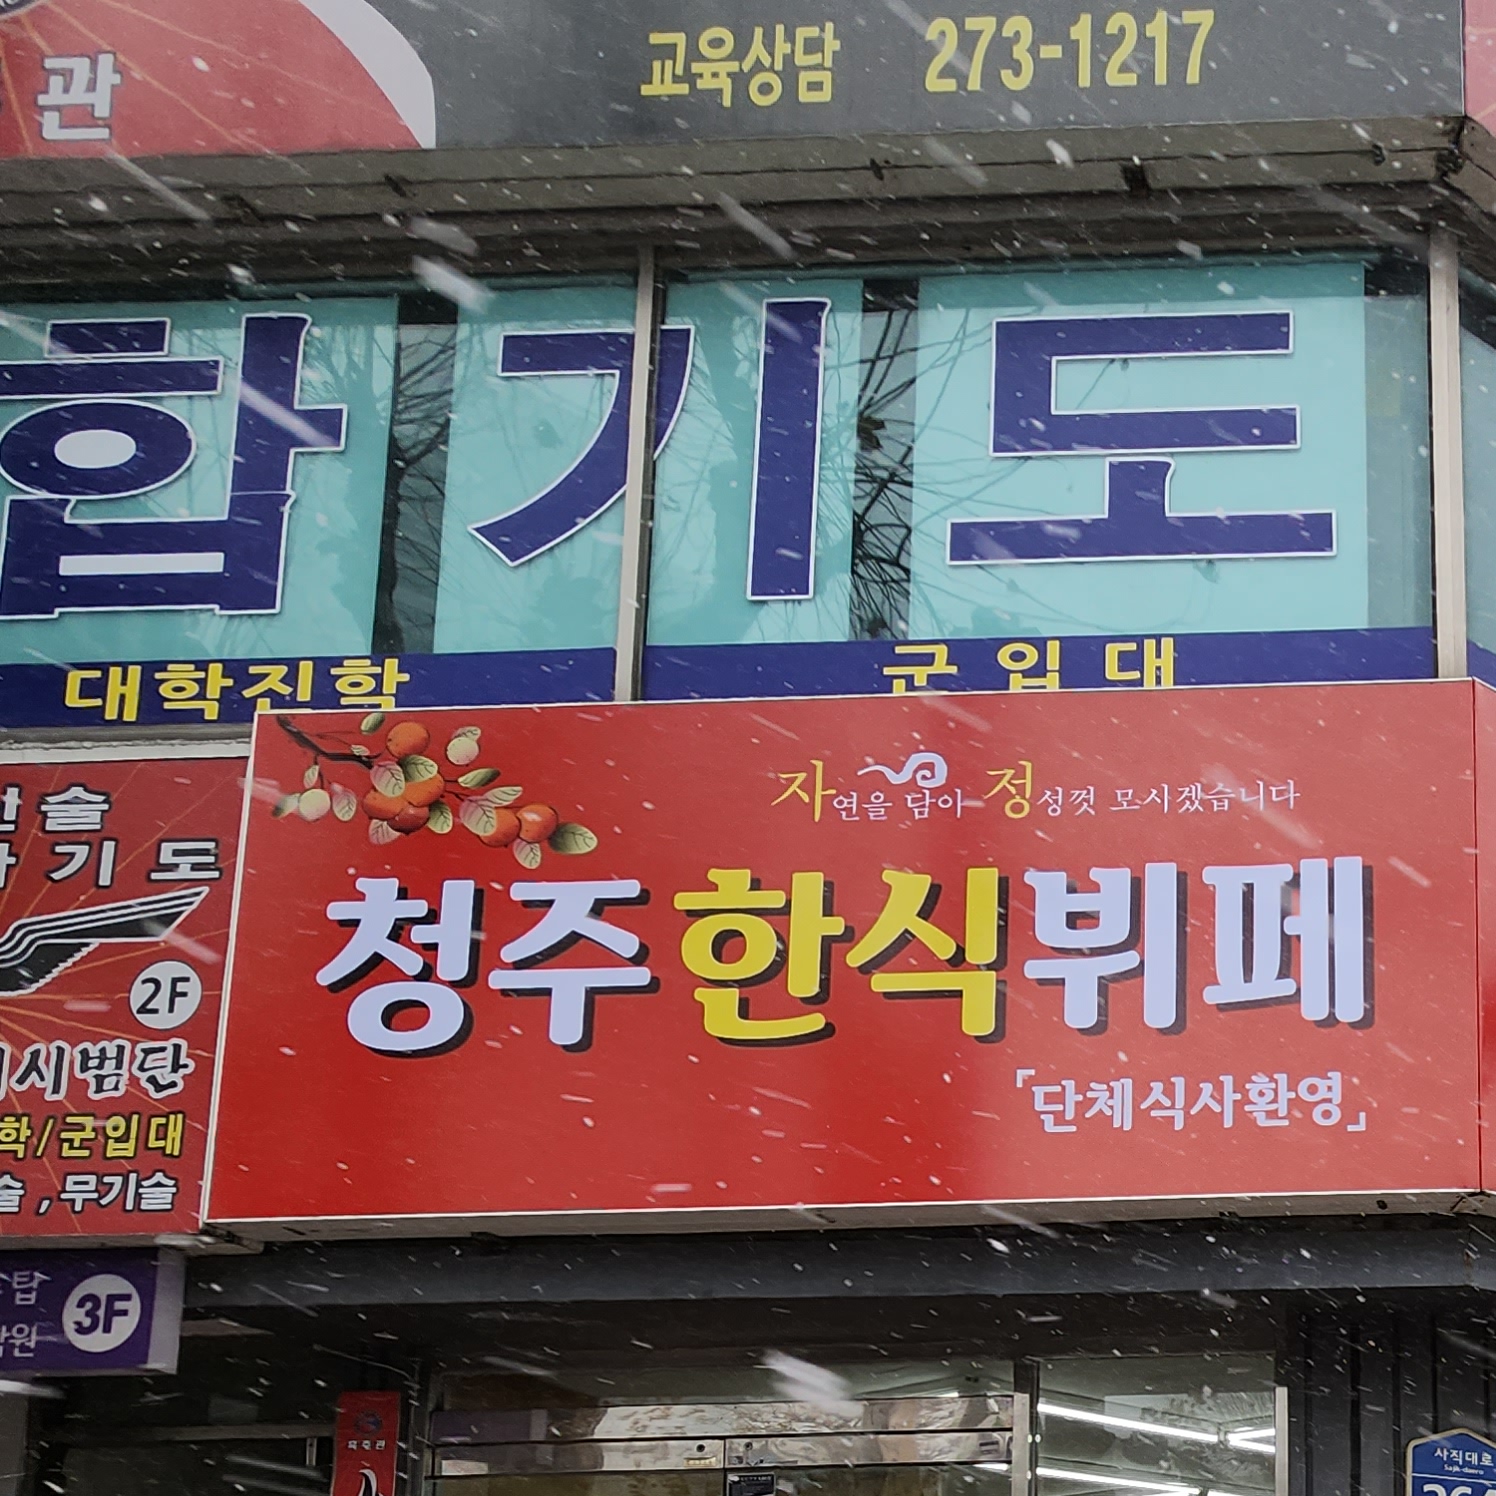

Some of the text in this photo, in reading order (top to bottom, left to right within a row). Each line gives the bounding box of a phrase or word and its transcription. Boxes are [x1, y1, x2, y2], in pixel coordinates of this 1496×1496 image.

[640, 9, 1216, 108] 교육상담 273-1217
[37, 52, 121, 141] 관
[0, 297, 1338, 622] 합기도
[63, 656, 411, 722] 대학진학
[771, 758, 1301, 823] 자연을 담아 정성껏 모시겠습니다
[316, 856, 1372, 1057] 청주한식뷔페
[136, 974, 192, 1017] 2F
[0, 1037, 197, 1102] 시범단
[73, 1292, 134, 1337] 3F
[1433, 1447, 1495, 1467] 사직대로
